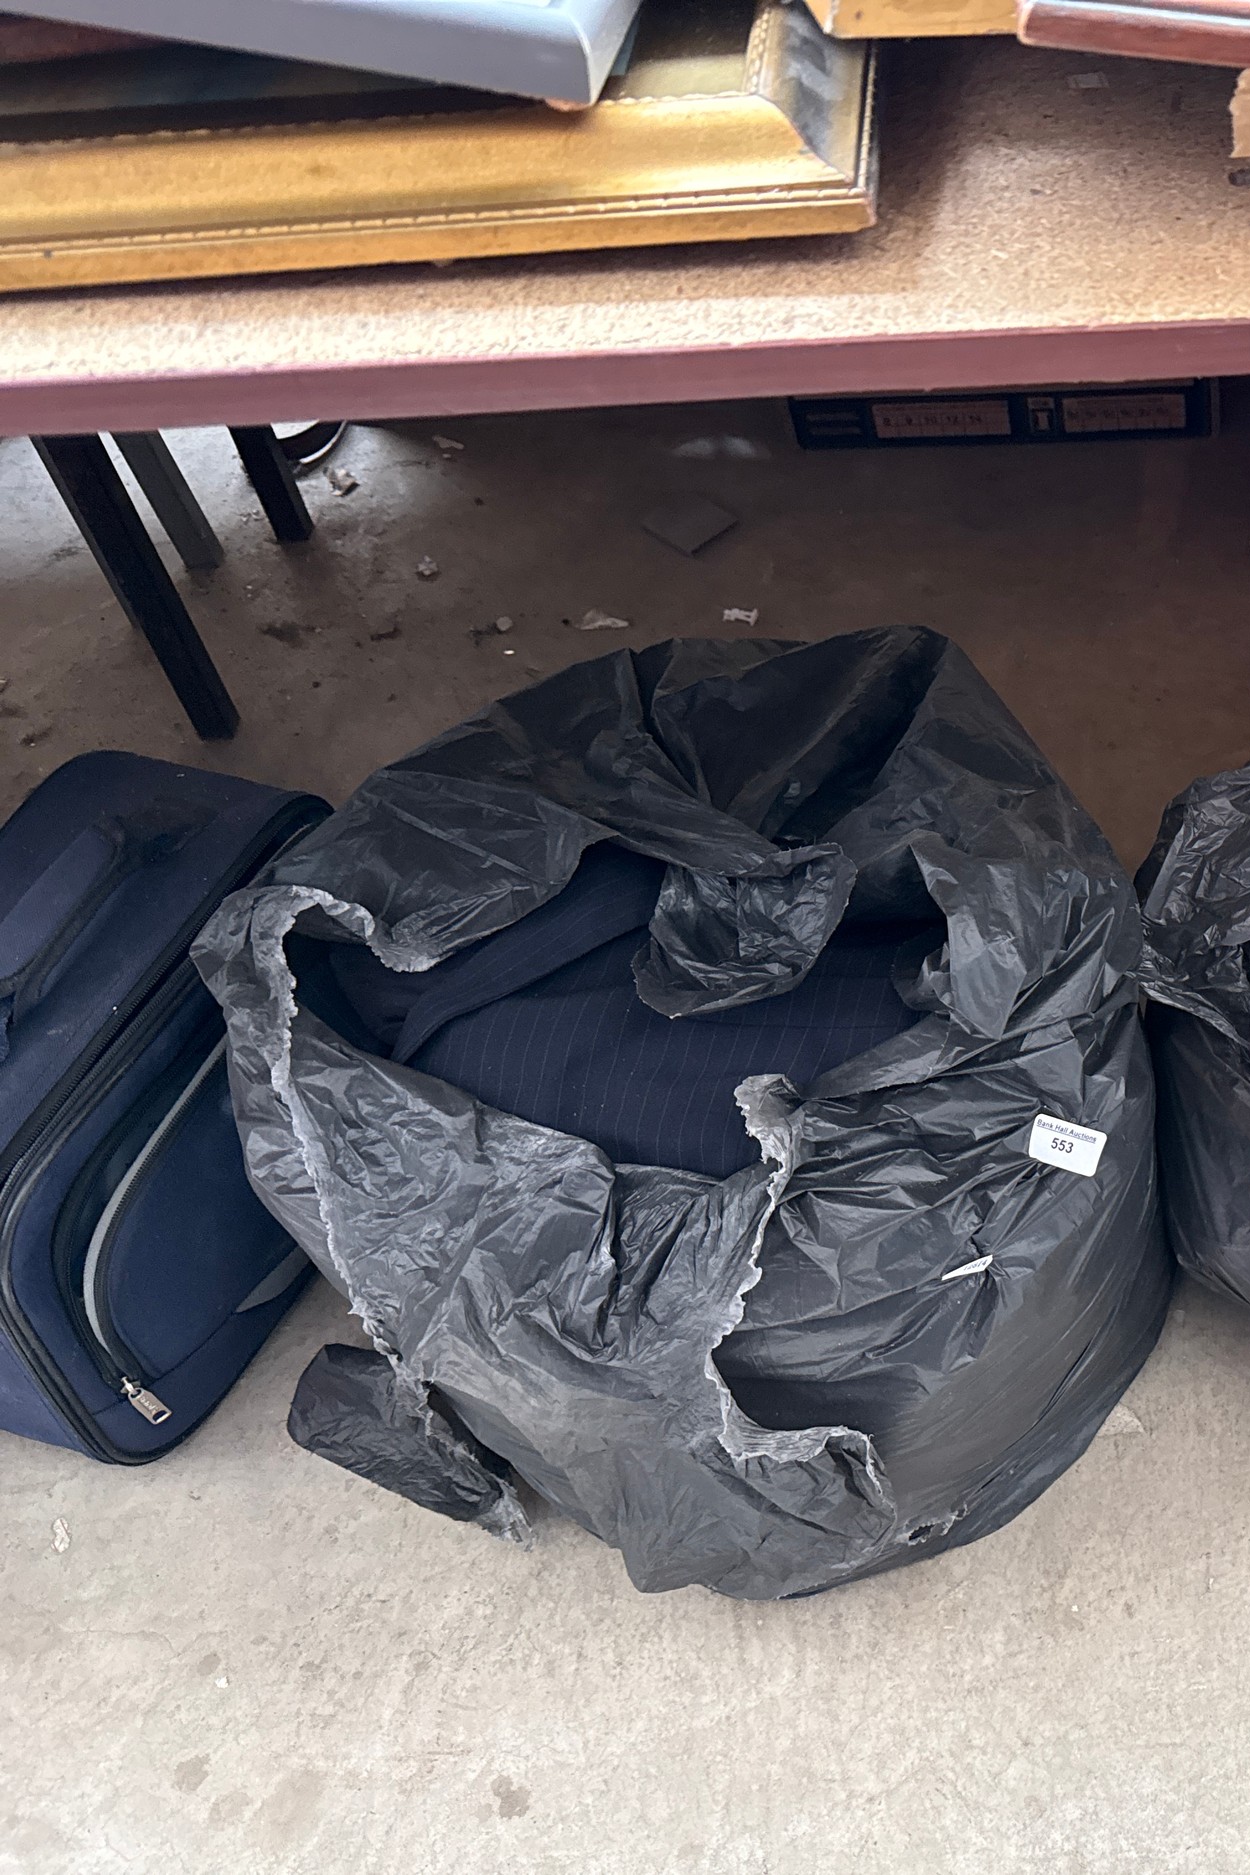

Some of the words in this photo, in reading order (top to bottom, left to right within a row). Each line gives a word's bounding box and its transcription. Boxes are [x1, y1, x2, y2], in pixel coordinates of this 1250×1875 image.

[1037, 1119, 1054, 1129] Bank
[1055, 1124, 1069, 1134] Hall
[1069, 1129, 1097, 1143] Auctions
[1051, 1137, 1074, 1154] 553
